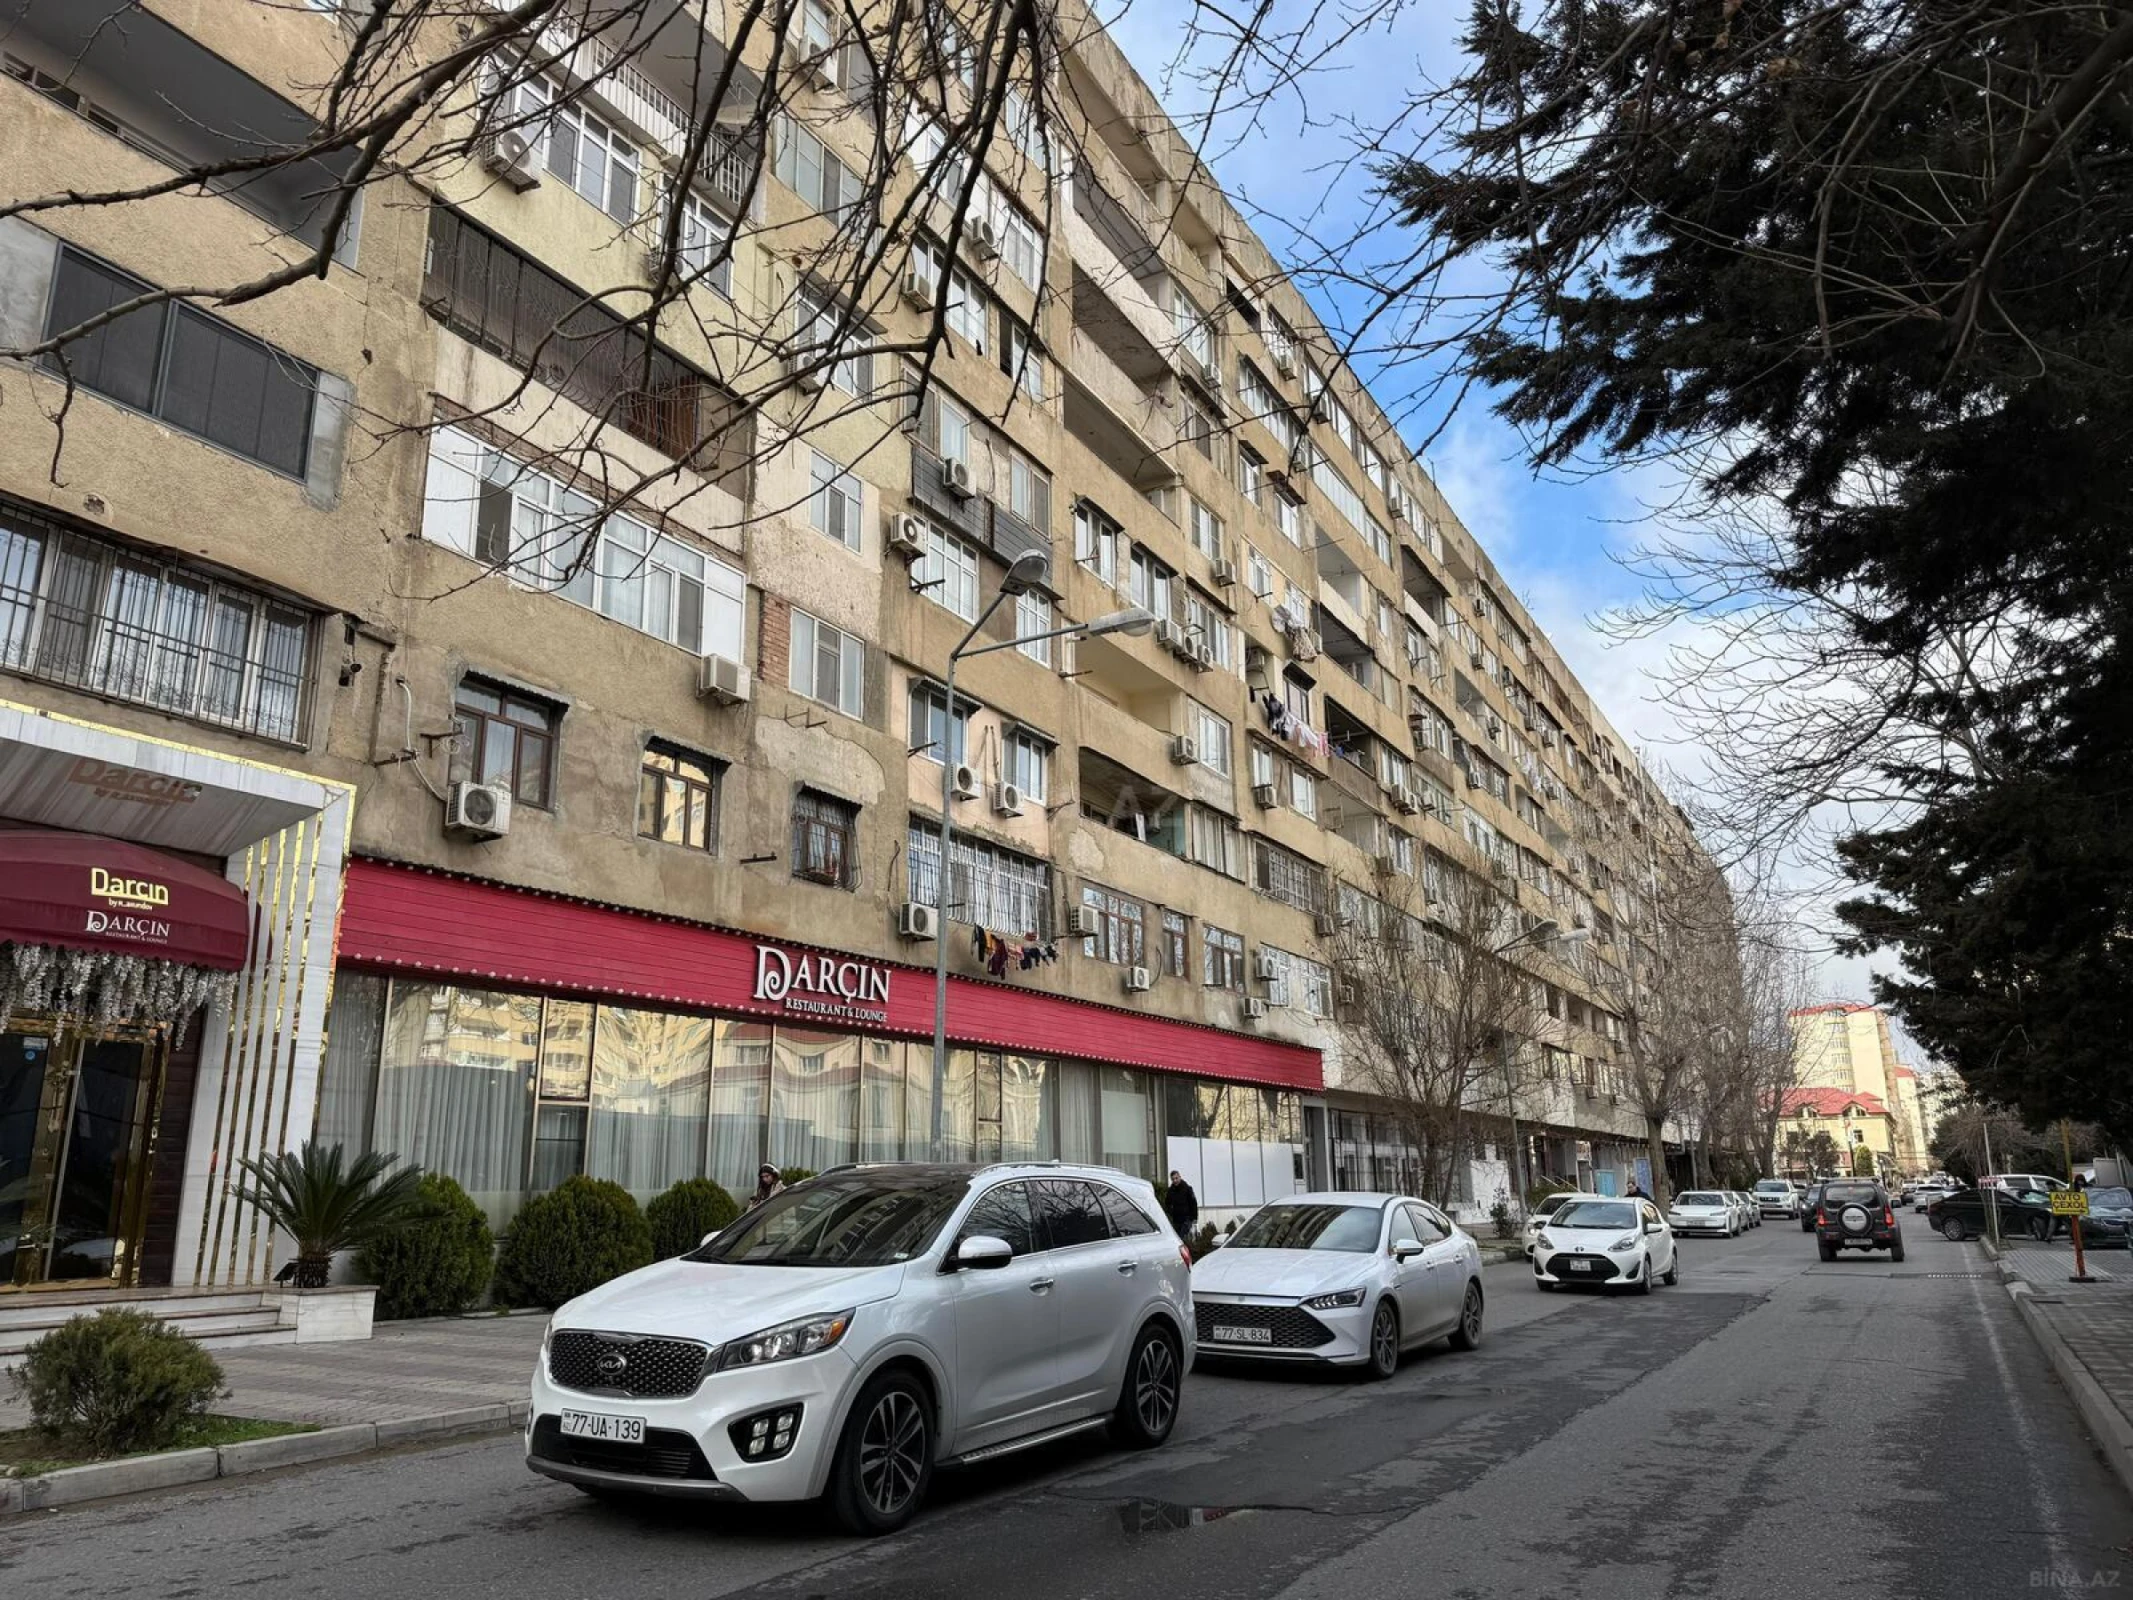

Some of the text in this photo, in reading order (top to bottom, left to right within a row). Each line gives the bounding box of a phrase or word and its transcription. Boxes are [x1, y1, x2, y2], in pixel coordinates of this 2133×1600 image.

[753, 945, 891, 1004] DARÇIN
[785, 997, 888, 1022] RESTAURANT & LOUNGE
[2054, 1193, 2081, 1201] AVTO
